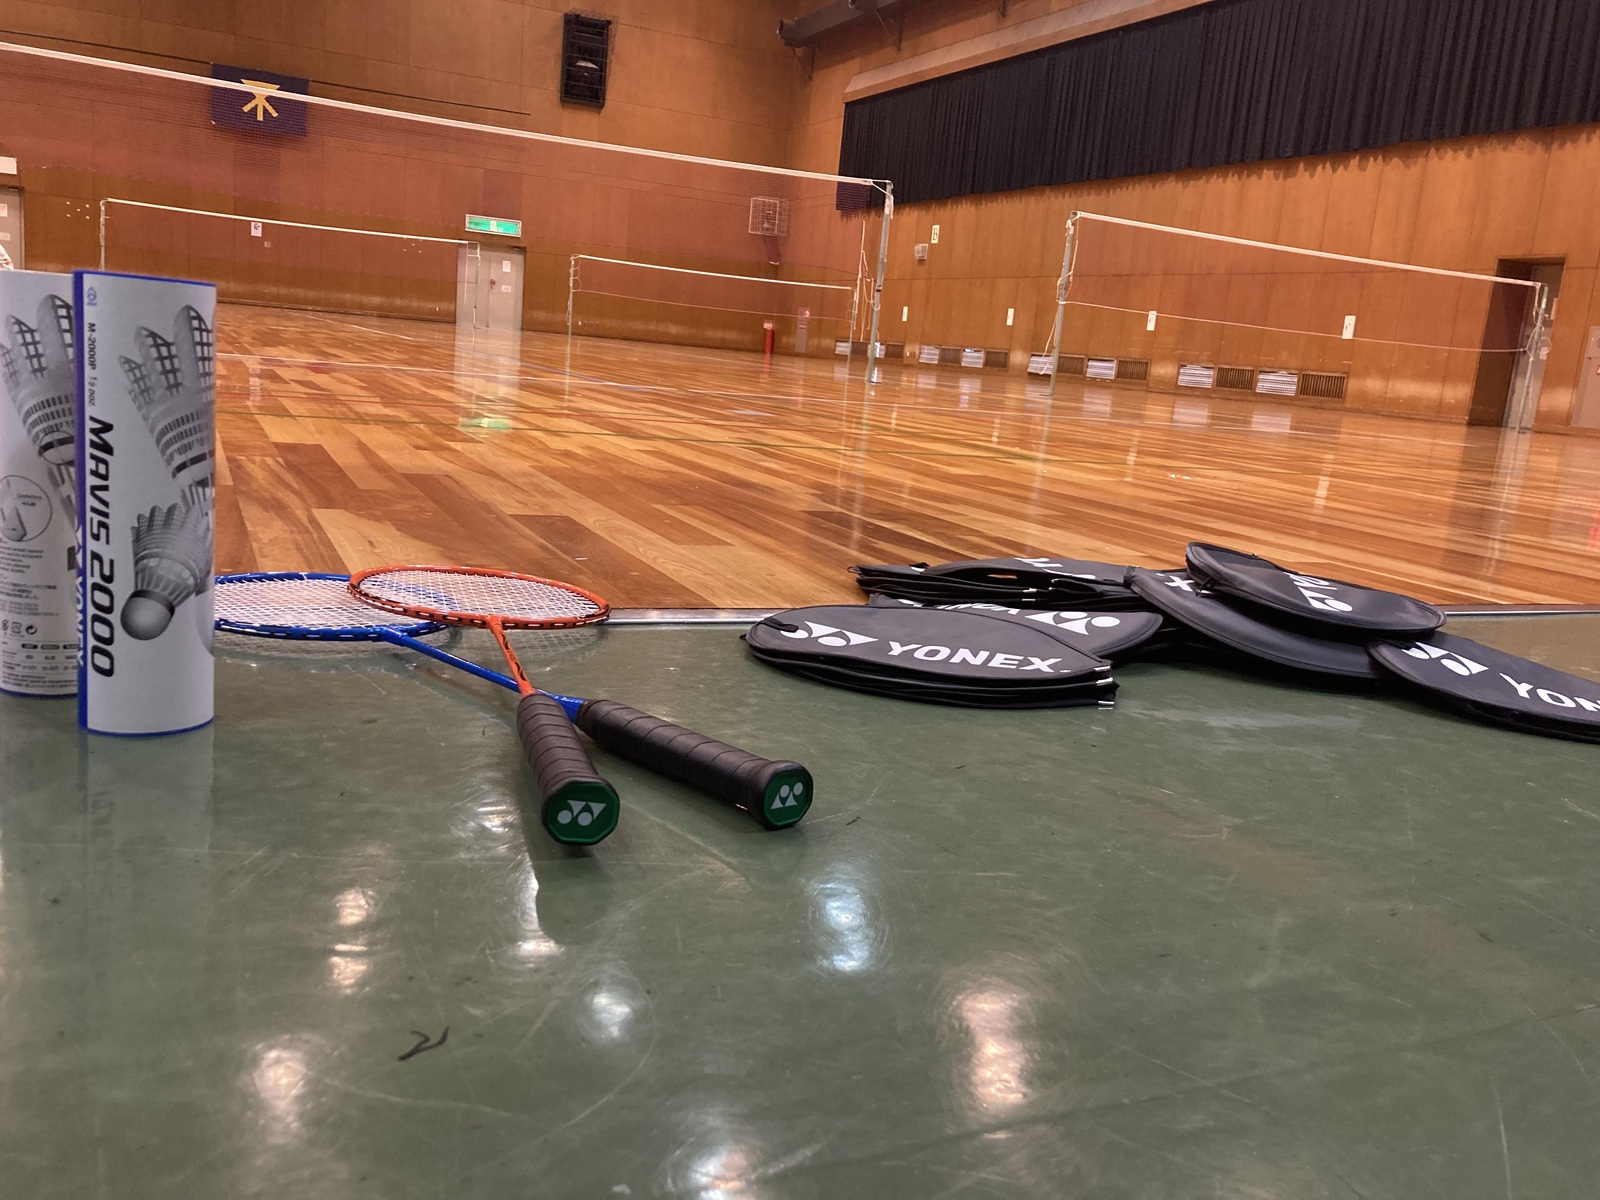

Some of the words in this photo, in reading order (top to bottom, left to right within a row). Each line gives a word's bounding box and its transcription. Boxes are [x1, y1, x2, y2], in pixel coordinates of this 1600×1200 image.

[88, 322, 97, 370] M-2000P
[89, 415, 114, 546] MAVIS
[90, 549, 115, 678] 2000
[887, 640, 1063, 673] YONEX
